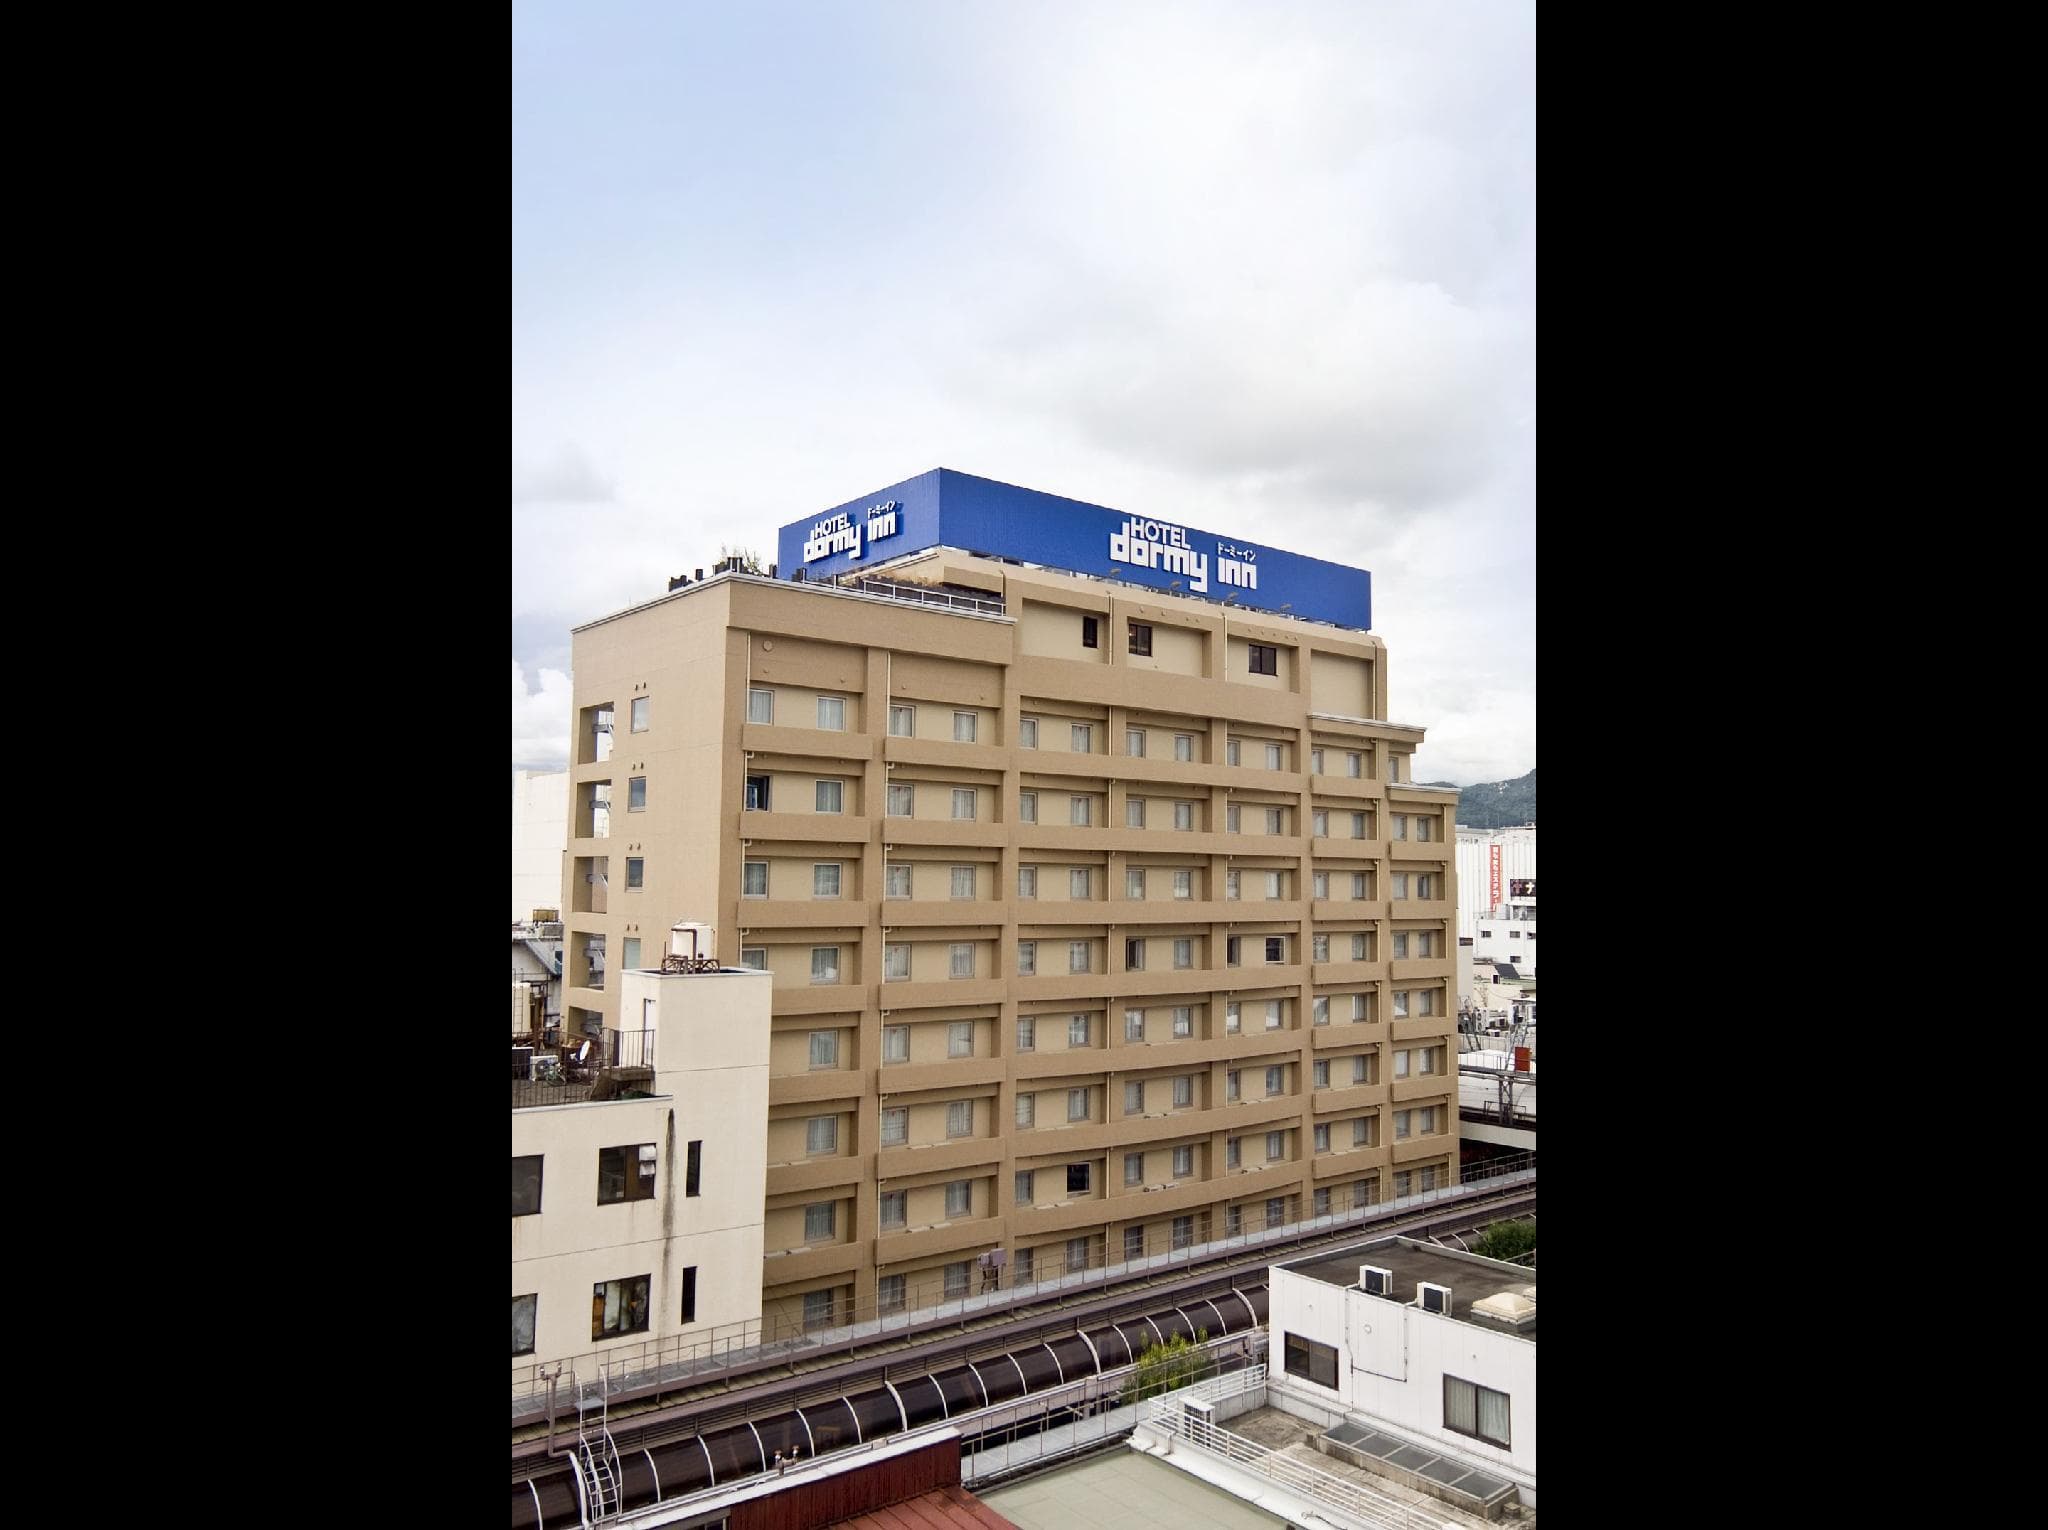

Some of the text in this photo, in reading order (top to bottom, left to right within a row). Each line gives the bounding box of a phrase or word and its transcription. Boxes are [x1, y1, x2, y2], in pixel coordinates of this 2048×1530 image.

[803, 511, 896, 563] dormy inn
[815, 512, 850, 539] HOTEL
[1130, 516, 1192, 550] HOTEL
[1110, 521, 1257, 593] dormy inn
[1217, 541, 1256, 563] ドーミーイン
